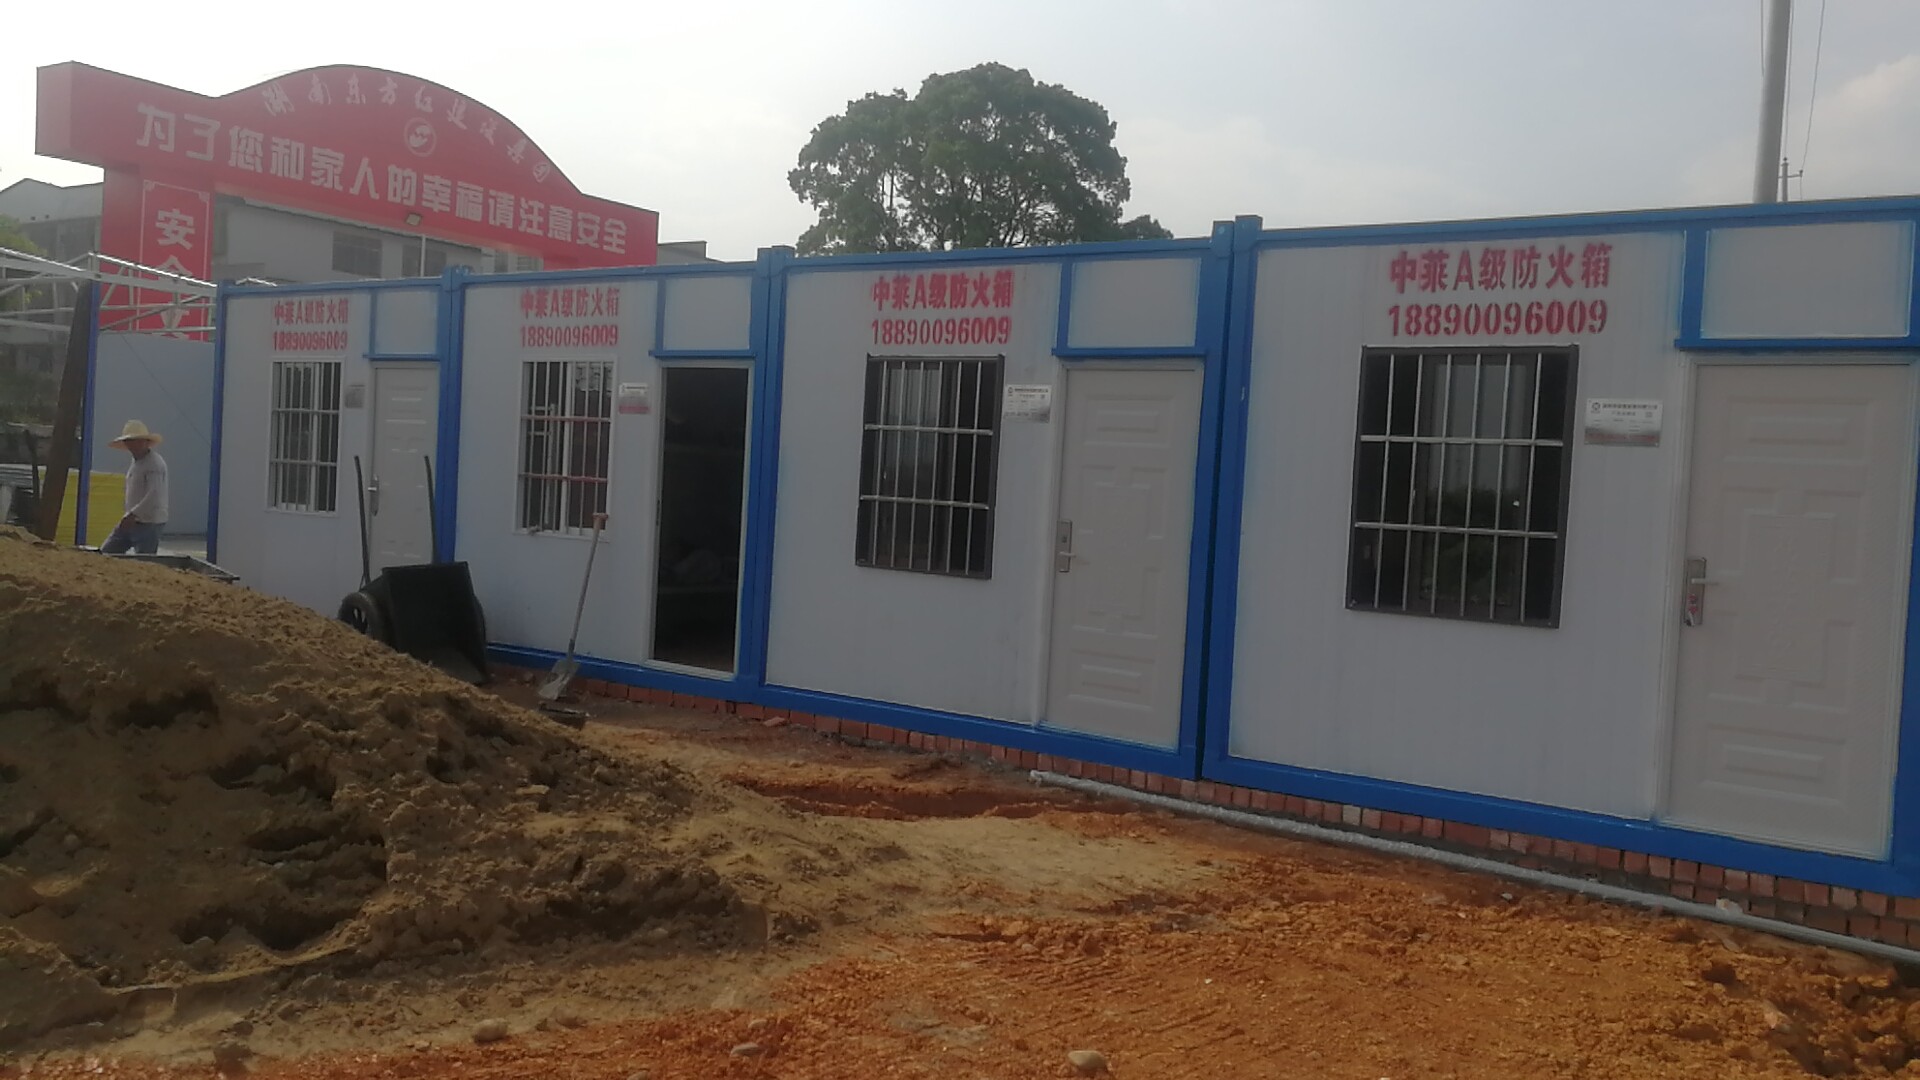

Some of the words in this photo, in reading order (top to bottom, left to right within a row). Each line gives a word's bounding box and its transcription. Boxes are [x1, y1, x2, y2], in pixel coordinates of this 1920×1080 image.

[137, 102, 627, 255] 为了您和家人的幸福请注意安全
[871, 315, 1012, 345] 18890096009
[1388, 299, 1608, 337] 18890096009
[273, 331, 347, 351] 18890096009
[521, 324, 618, 348] 18890096009
